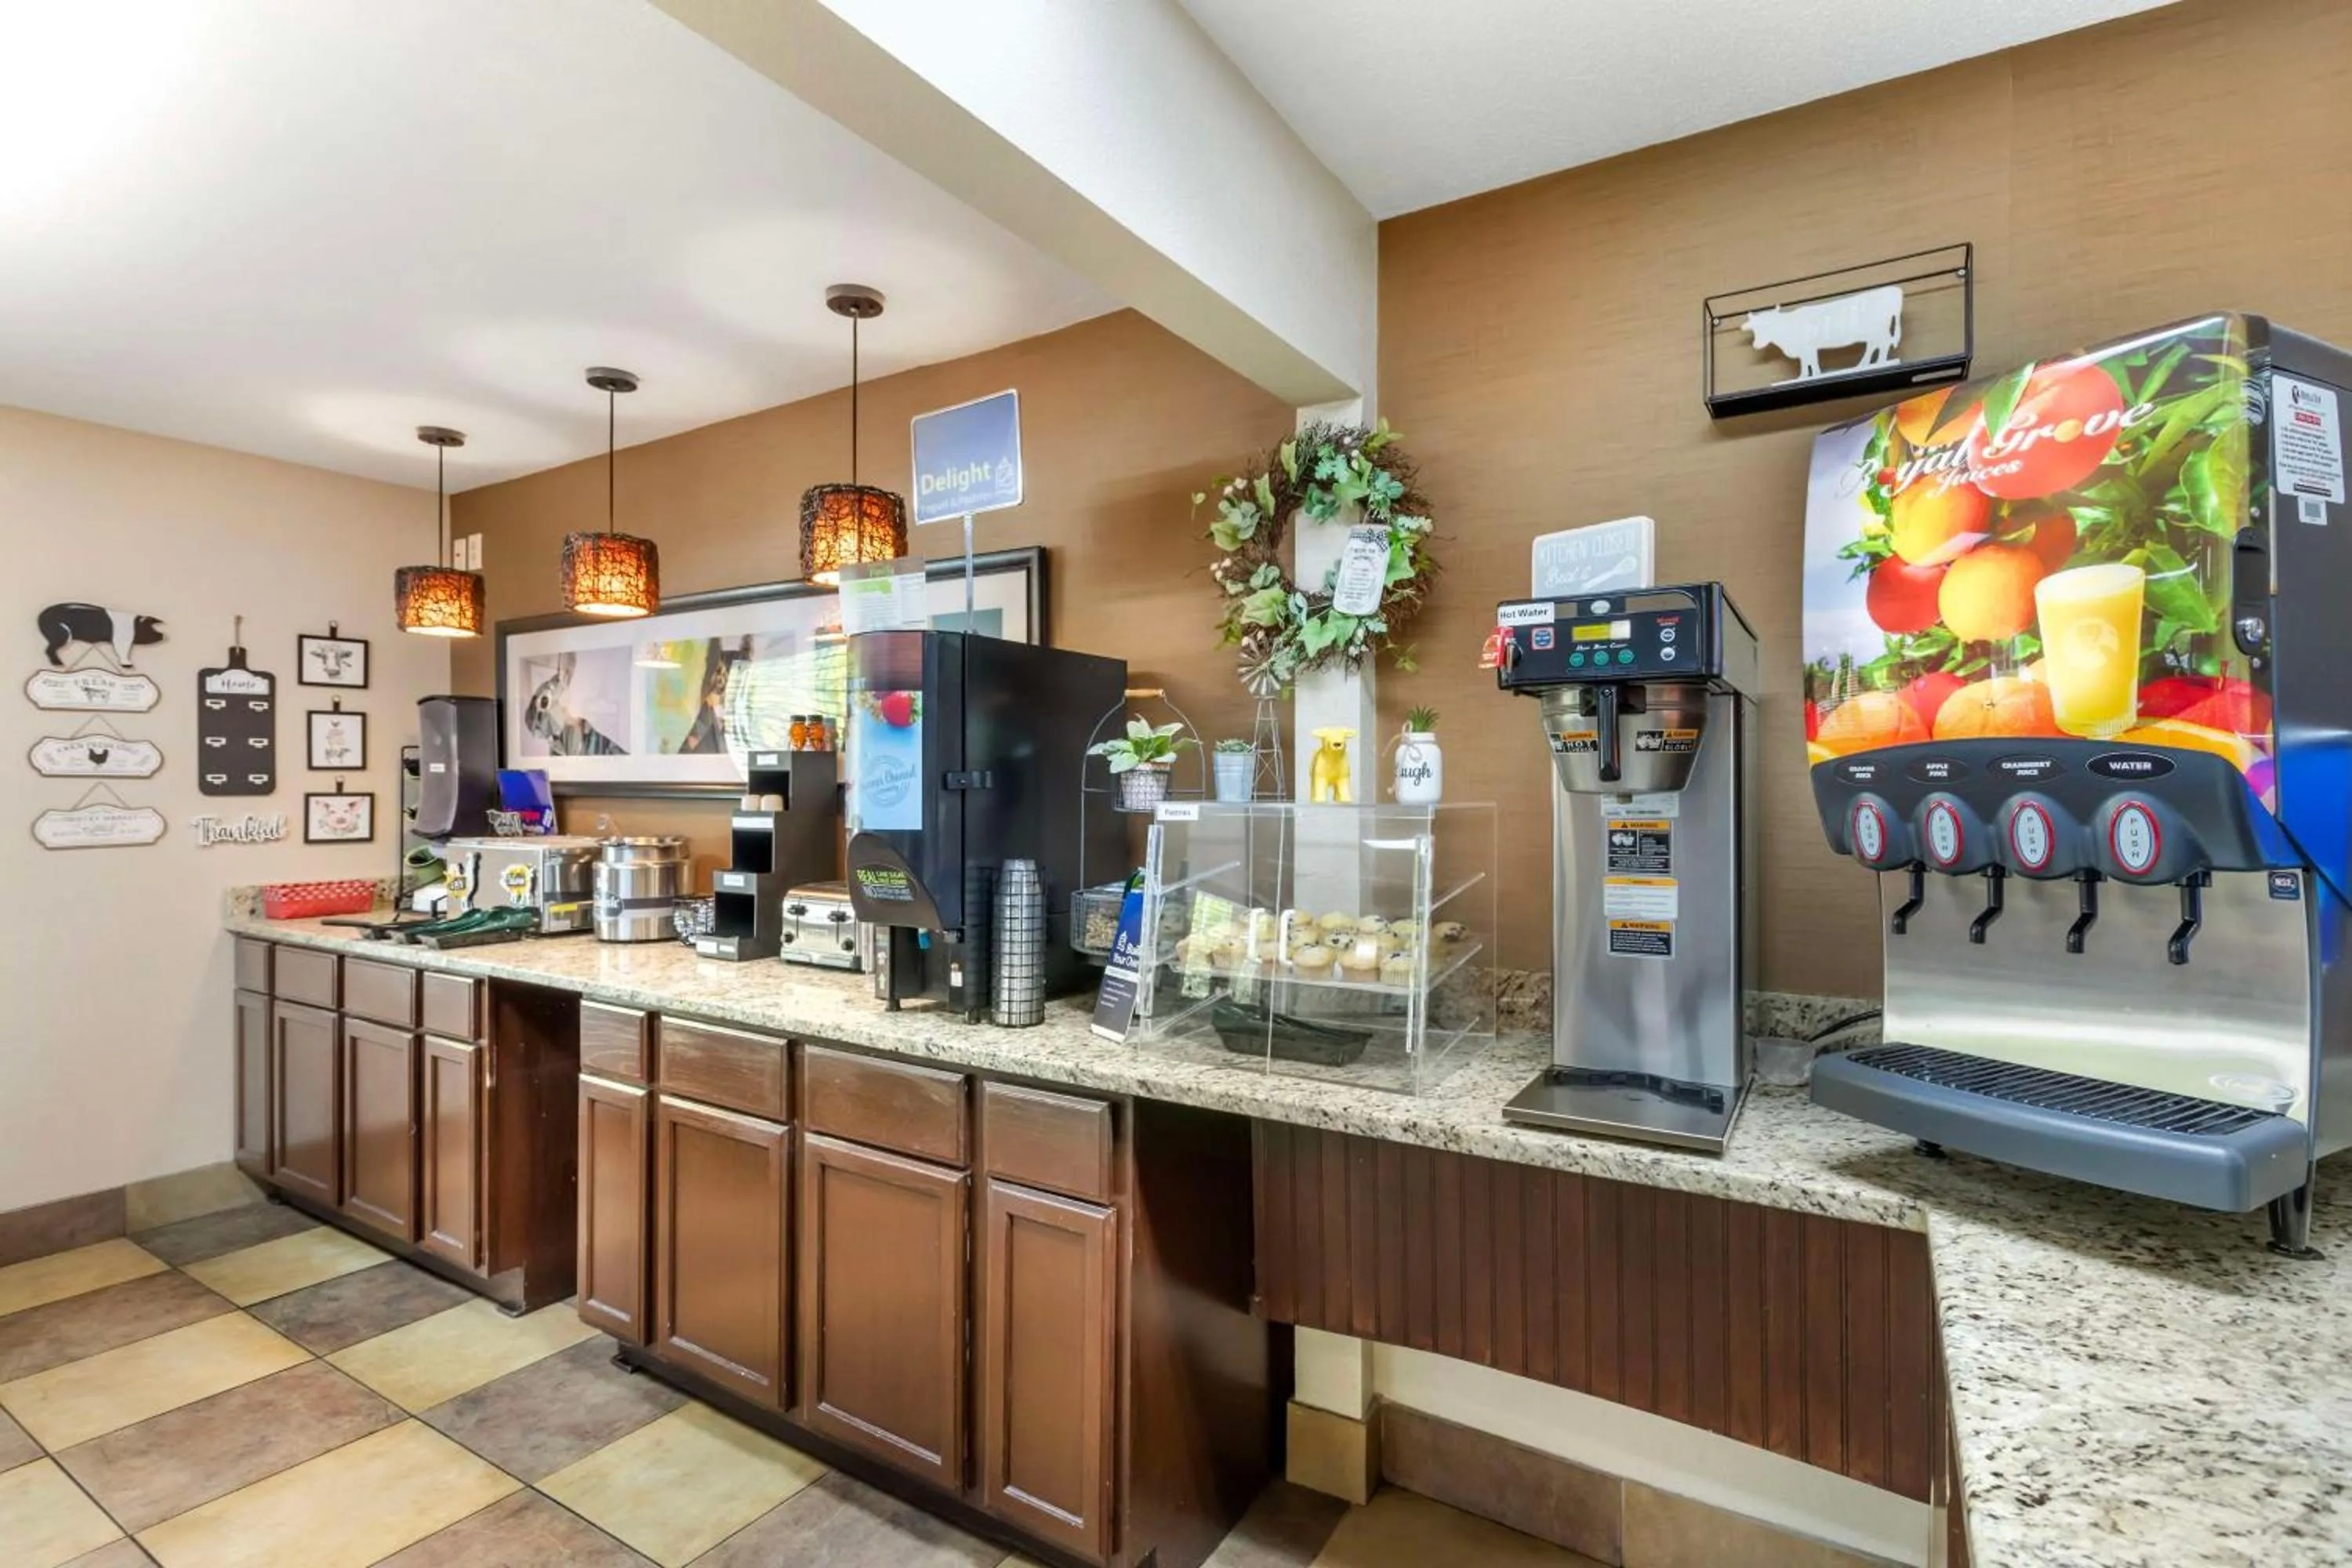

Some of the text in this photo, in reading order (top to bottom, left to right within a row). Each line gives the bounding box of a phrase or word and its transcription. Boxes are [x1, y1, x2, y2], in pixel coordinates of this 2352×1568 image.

[920, 461, 992, 495] Delight
[1500, 608, 1548, 619] Hot Water
[2002, 760, 2052, 769] CRANBERRY
[2108, 761, 2152, 771] WATER
[191, 812, 288, 846] Thankful
[2027, 816, 2038, 855] PUSH
[2129, 818, 2140, 858] PUSH
